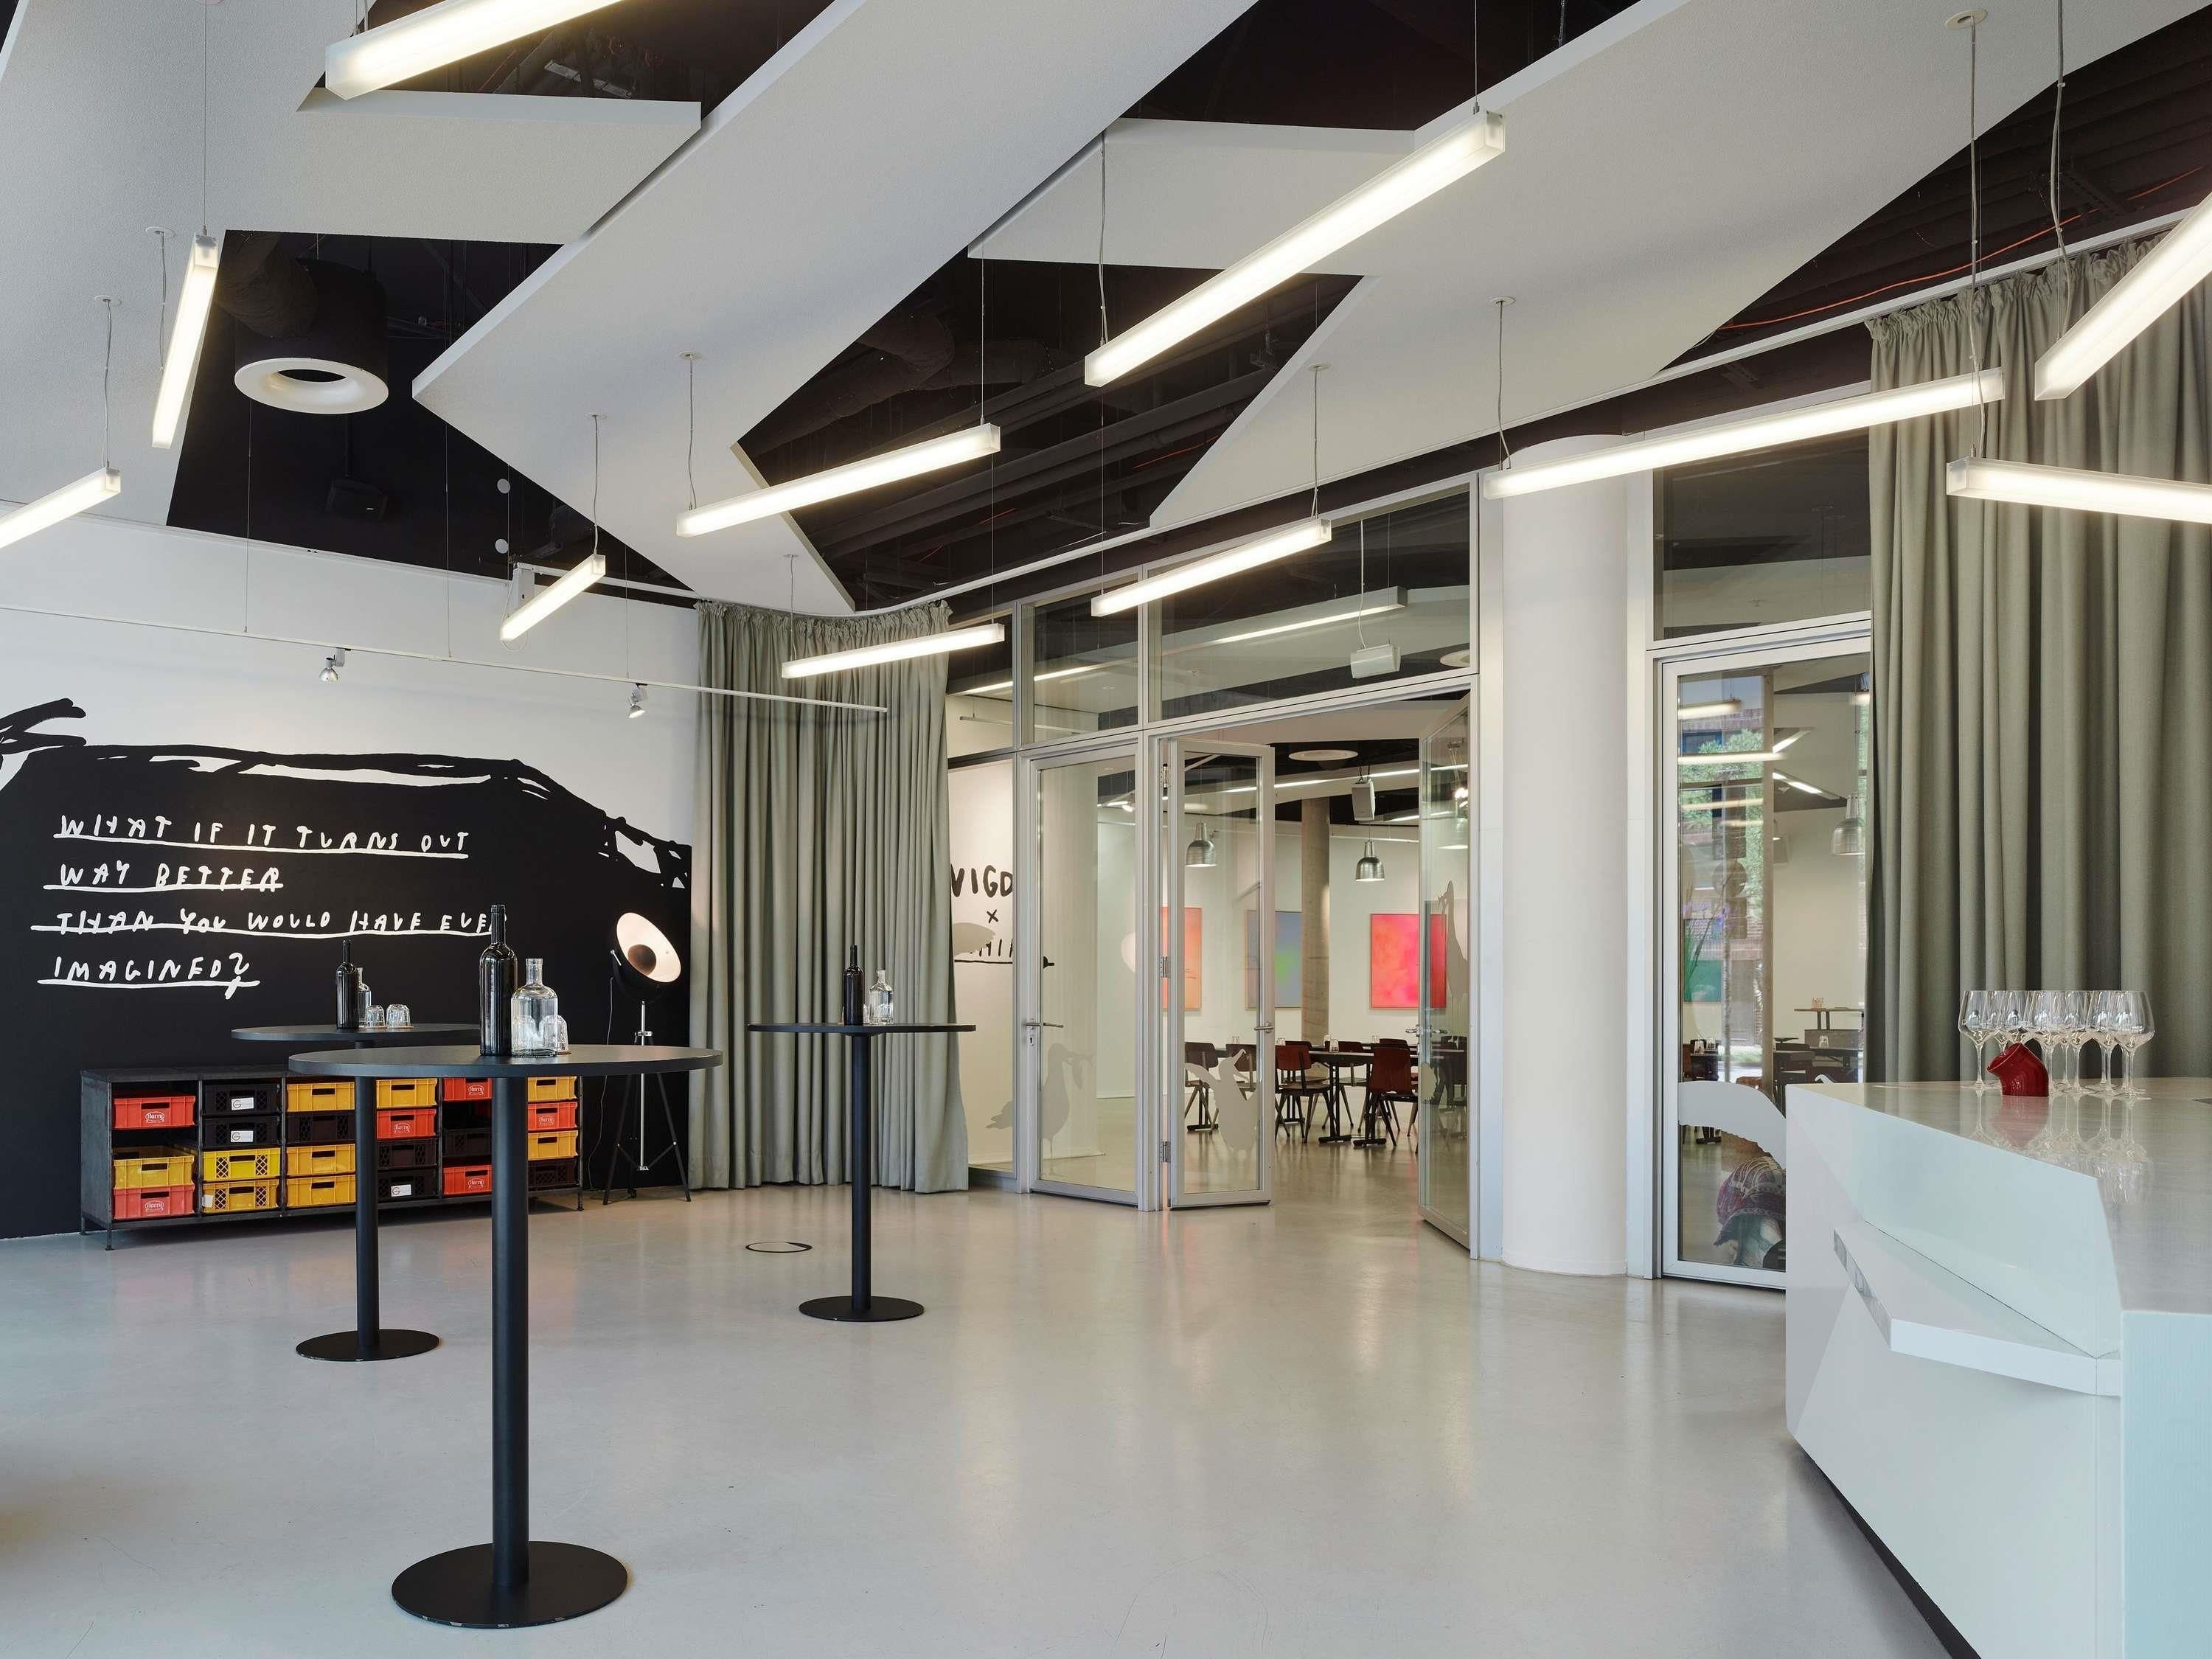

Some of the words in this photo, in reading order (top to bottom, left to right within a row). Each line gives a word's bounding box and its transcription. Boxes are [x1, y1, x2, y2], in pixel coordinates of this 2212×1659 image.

[61, 814, 172, 838] WHAT
[194, 822, 223, 844] IF
[247, 824, 276, 846] IT
[296, 825, 398, 850] TURNS
[420, 832, 469, 852] OUT
[60, 860, 130, 886] WAY
[156, 863, 279, 892] BETTER
[57, 910, 153, 935] THAN
[180, 908, 226, 934] YOU
[248, 911, 330, 931] WOULD
[349, 911, 421, 933] HAVE
[54, 952, 249, 1000] IMAGINED?
[147, 1112, 164, 1121] Harry
[147, 1201, 164, 1210] Harry
